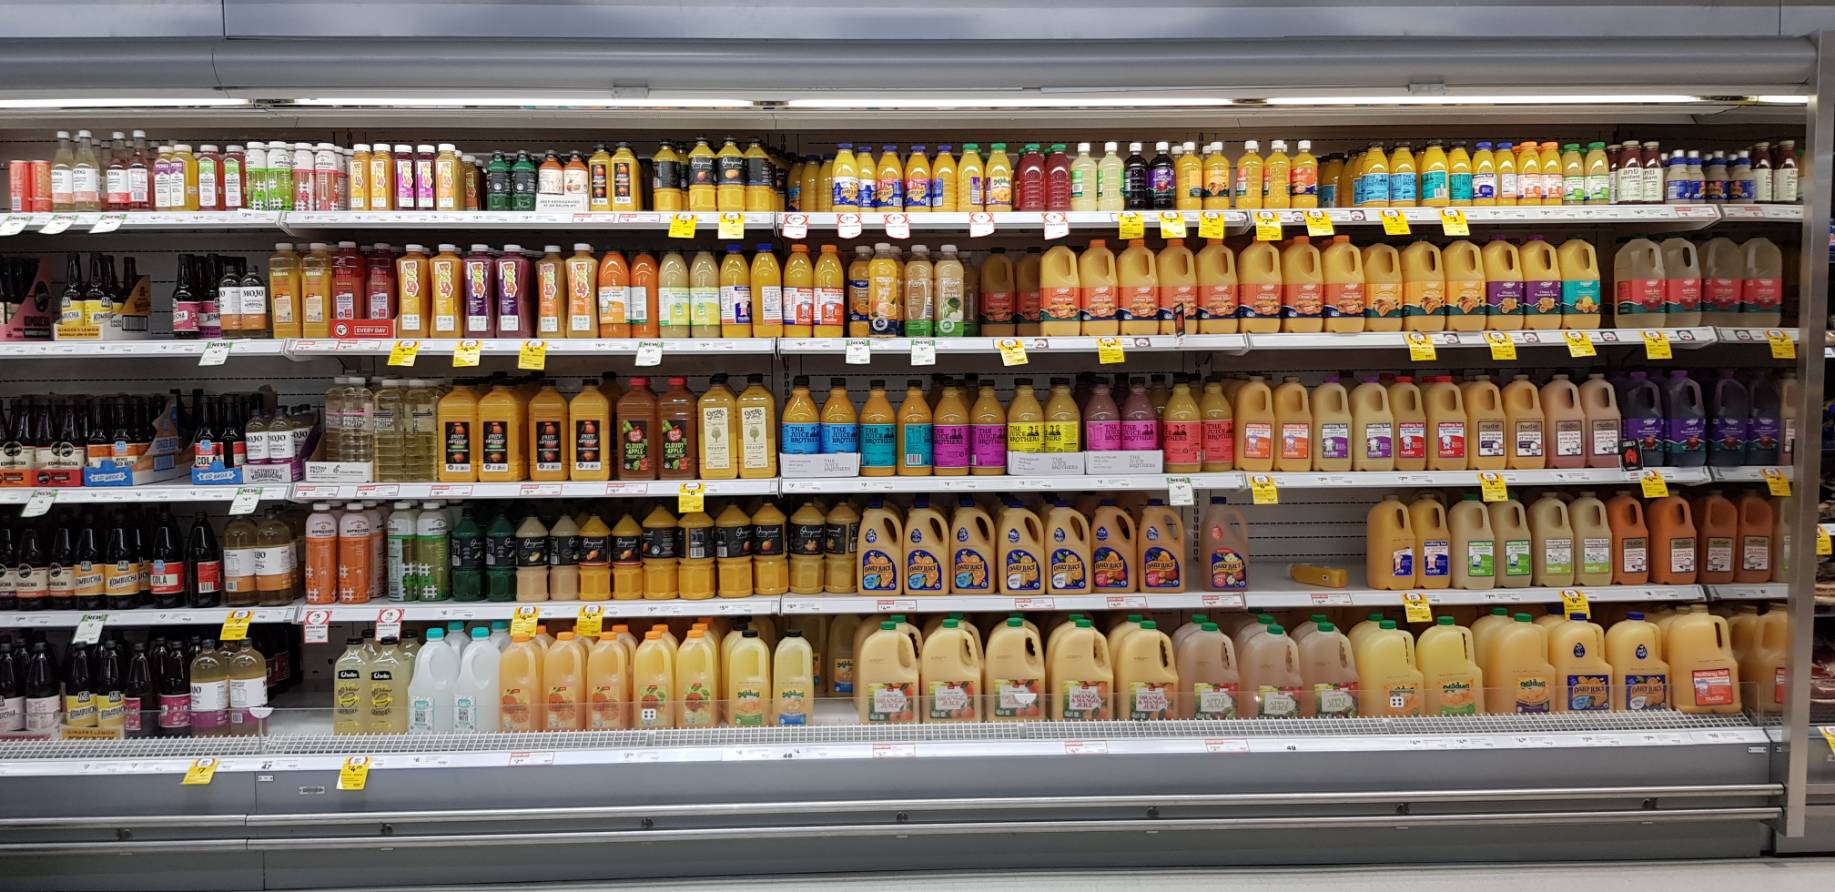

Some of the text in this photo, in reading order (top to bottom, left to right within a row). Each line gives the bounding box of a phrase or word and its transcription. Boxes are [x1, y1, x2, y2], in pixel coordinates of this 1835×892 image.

[197, 456, 216, 465] COLA
[756, 527, 779, 536] Original
[800, 527, 822, 538] Original
[524, 538, 545, 548] Original
[583, 538, 604, 546] Original
[616, 537, 637, 546] Original
[879, 564, 891, 572] JUICE
[1008, 564, 1022, 572] DAILY
[1053, 563, 1080, 572] DAILY JUICE
[1095, 561, 1122, 570] DAILY JUICE
[1147, 561, 1174, 570] DAILY JUICE
[1213, 561, 1241, 570] DAILY JUICE
[109, 574, 138, 587] KOMBUCHA
[152, 576, 168, 585] COLA
[1574, 684, 1606, 694] DAILY JUICE
[1632, 684, 1664, 694] DAILY JUICE
